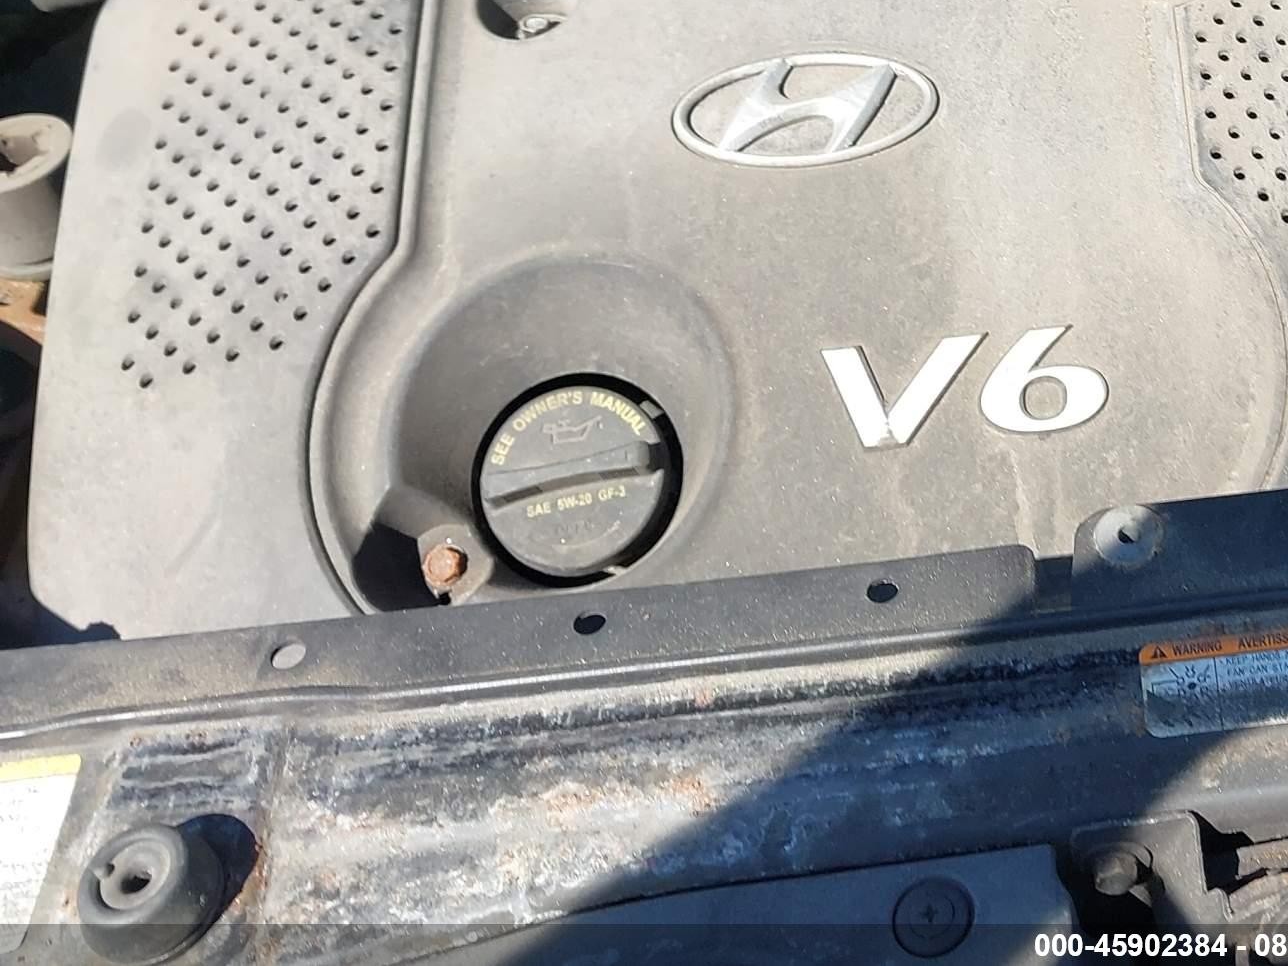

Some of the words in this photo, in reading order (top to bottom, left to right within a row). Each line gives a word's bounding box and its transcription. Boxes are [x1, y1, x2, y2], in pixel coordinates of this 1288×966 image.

[820, 324, 1109, 451] V6
[491, 433, 516, 466] SEE
[513, 391, 584, 432] OWNER'S
[590, 391, 647, 436] MANUAL
[526, 501, 551, 517] SAE
[557, 493, 593, 511] 5W-20
[1172, 641, 1223, 656] WARNING
